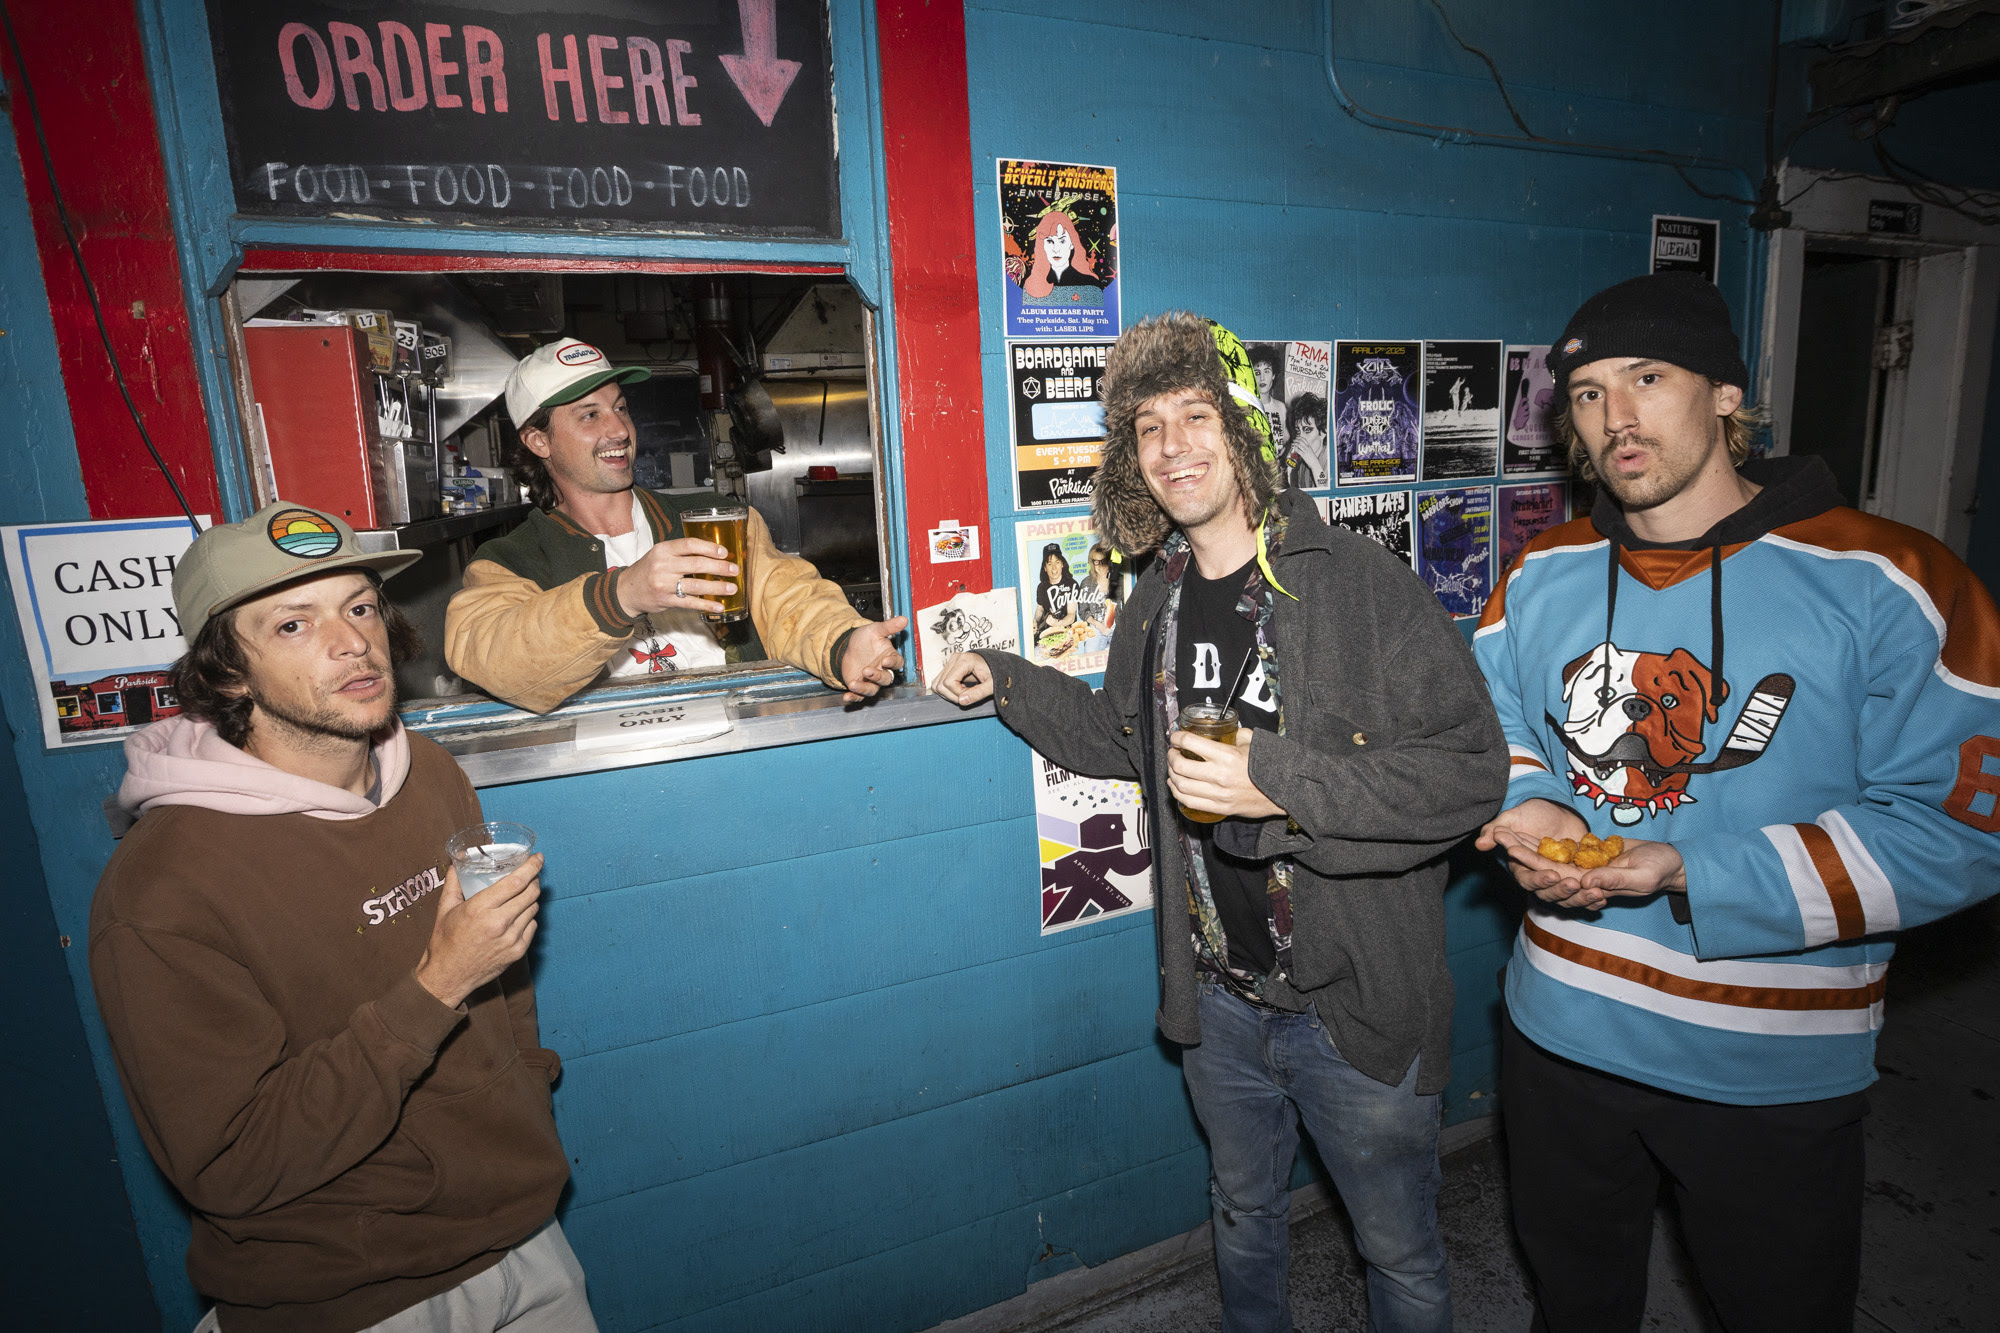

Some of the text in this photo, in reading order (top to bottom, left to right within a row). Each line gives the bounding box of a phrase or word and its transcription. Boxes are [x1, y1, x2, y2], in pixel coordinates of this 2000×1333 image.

[278, 21, 702, 126] ORDER HERE
[267, 162, 751, 209] FOOD FOOD FOOD FOOD
[1004, 167, 1114, 191] BEVERLY CRUSHERS
[1019, 188, 1100, 200] ENTERPRISE
[1660, 223, 1692, 235] NATURE
[1658, 239, 1698, 259] METAL
[359, 315, 374, 327] 17
[398, 333, 413, 347] 23
[425, 346, 445, 358] 808
[1351, 346, 1373, 354] APRIL
[1386, 346, 1406, 354] 2025
[1061, 367, 1074, 376] AND
[1290, 364, 1326, 379] THURSDAYS
[1510, 357, 1520, 371] IS
[1045, 376, 1092, 399] BEERS
[1286, 376, 1324, 397] Parkside
[1360, 400, 1394, 411] FROLIC
[1036, 444, 1103, 456] EVERY TUESDA
[1053, 457, 1059, 465] 5
[1069, 456, 1075, 464] 9
[1077, 455, 1091, 463] PM
[1049, 477, 1093, 499] Parkside
[1332, 496, 1374, 521] CANCER
[1422, 495, 1464, 521] HARDCORE SHOW
[1027, 521, 1074, 537] PARTY
[54, 555, 176, 594] CASH
[1047, 582, 1105, 614] Parkside
[941, 636, 991, 656] TIPS GET
[114, 676, 158, 689] Parkside
[619, 706, 685, 718] CASH
[619, 714, 686, 728] ONLY
[1045, 770, 1070, 787] FILM
[1073, 859, 1091, 875] APRIL
[1092, 874, 1100, 882] 17
[1116, 894, 1130, 907] 2025
